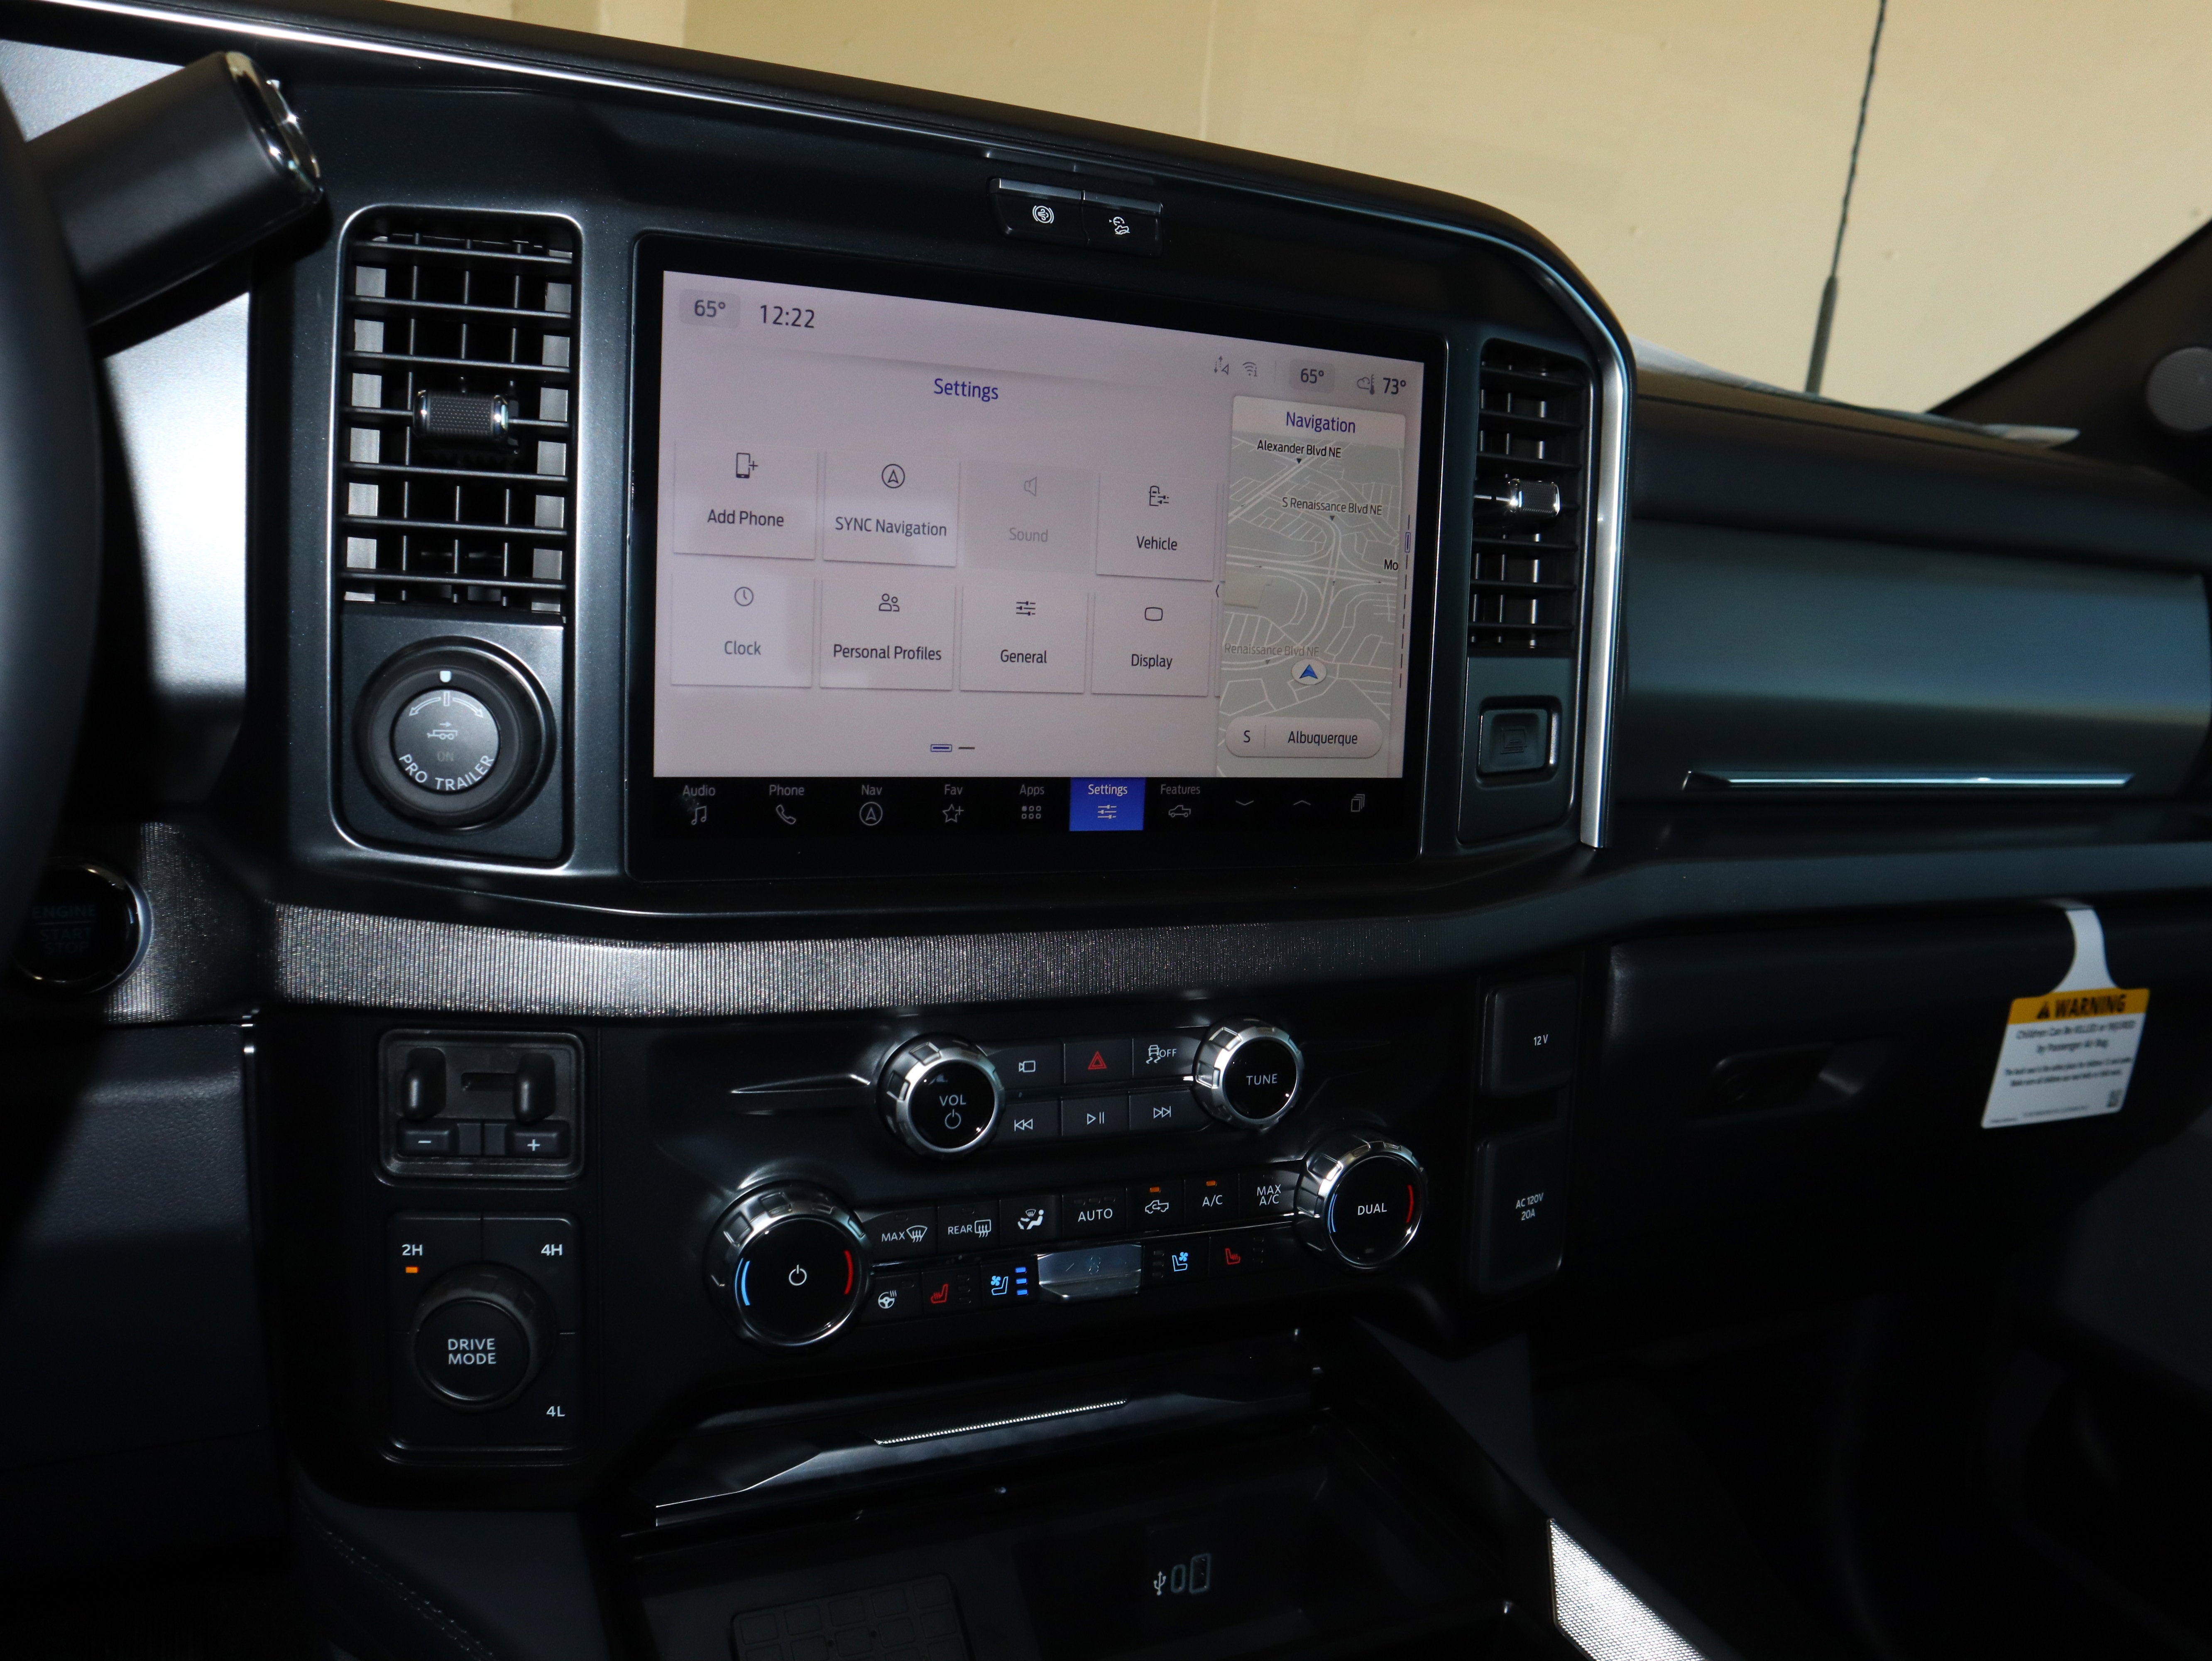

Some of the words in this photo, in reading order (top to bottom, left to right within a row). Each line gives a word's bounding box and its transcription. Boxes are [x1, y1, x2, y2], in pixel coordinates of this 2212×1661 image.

[693, 299, 726, 318] 65°
[759, 304, 815, 328] 12:22
[1300, 368, 1324, 384] 65°
[933, 377, 999, 402] Settings
[1382, 377, 1407, 395] 73°
[1286, 411, 1356, 434] Navigation
[1257, 439, 1305, 455] Alexander
[1306, 444, 1327, 457] Blvd
[1329, 447, 1342, 458] NE
[1282, 497, 1289, 508] S
[1290, 498, 1347, 512] Renaissance
[1348, 502, 1368, 514] Blvd
[1370, 505, 1382, 515] NE
[707, 509, 736, 526] Add
[739, 510, 785, 527] Phone
[834, 516, 872, 533] SYNC
[875, 519, 947, 537] Navigation
[1008, 527, 1049, 542] Sound
[1136, 535, 1178, 551] Vehicle
[1384, 558, 1399, 571] Mo
[724, 640, 762, 656] Clock
[833, 644, 891, 660] Personal
[894, 645, 942, 661] Profiles
[1225, 643, 1282, 656] Renaissance
[1284, 645, 1304, 657] Blvd
[1307, 646, 1319, 657] NE
[1000, 649, 1047, 664] General
[1130, 653, 1173, 670] Display
[1243, 730, 1251, 743] S
[1287, 730, 1358, 746] Albuquerque
[399, 753, 428, 784] PRO
[434, 755, 494, 791] TRAILER
[682, 784, 716, 796] Audio
[769, 784, 805, 796] Phone
[861, 784, 883, 796] Nav
[944, 784, 963, 796] Fav
[1019, 784, 1045, 797] Apps
[1088, 784, 1128, 797] Settings
[1160, 784, 1201, 795] Features
[2055, 995, 2127, 1017] WARNING
[1534, 1036, 1542, 1046] 12
[1543, 1034, 1549, 1044] V
[1159, 1049, 1177, 1058] OFF
[1246, 1073, 1278, 1085] TUNE
[939, 1095, 966, 1107] VOL
[1257, 1183, 1282, 1197] MAX
[1202, 1194, 1223, 1207] A/C
[1259, 1194, 1280, 1206] A/C
[1515, 1198, 1526, 1209] AC
[1527, 1192, 1544, 1205] 120V
[1078, 1208, 1113, 1222] AUTO
[1357, 1203, 1387, 1216] DUAL
[1521, 1208, 1535, 1221] 20A
[947, 1224, 973, 1235] REAR
[881, 1231, 905, 1243] MAX
[401, 1244, 423, 1256] 2H
[541, 1244, 563, 1256] 4H
[448, 1338, 496, 1351] DRIVE
[448, 1353, 497, 1365] MODE
[546, 1406, 565, 1417] 4L
